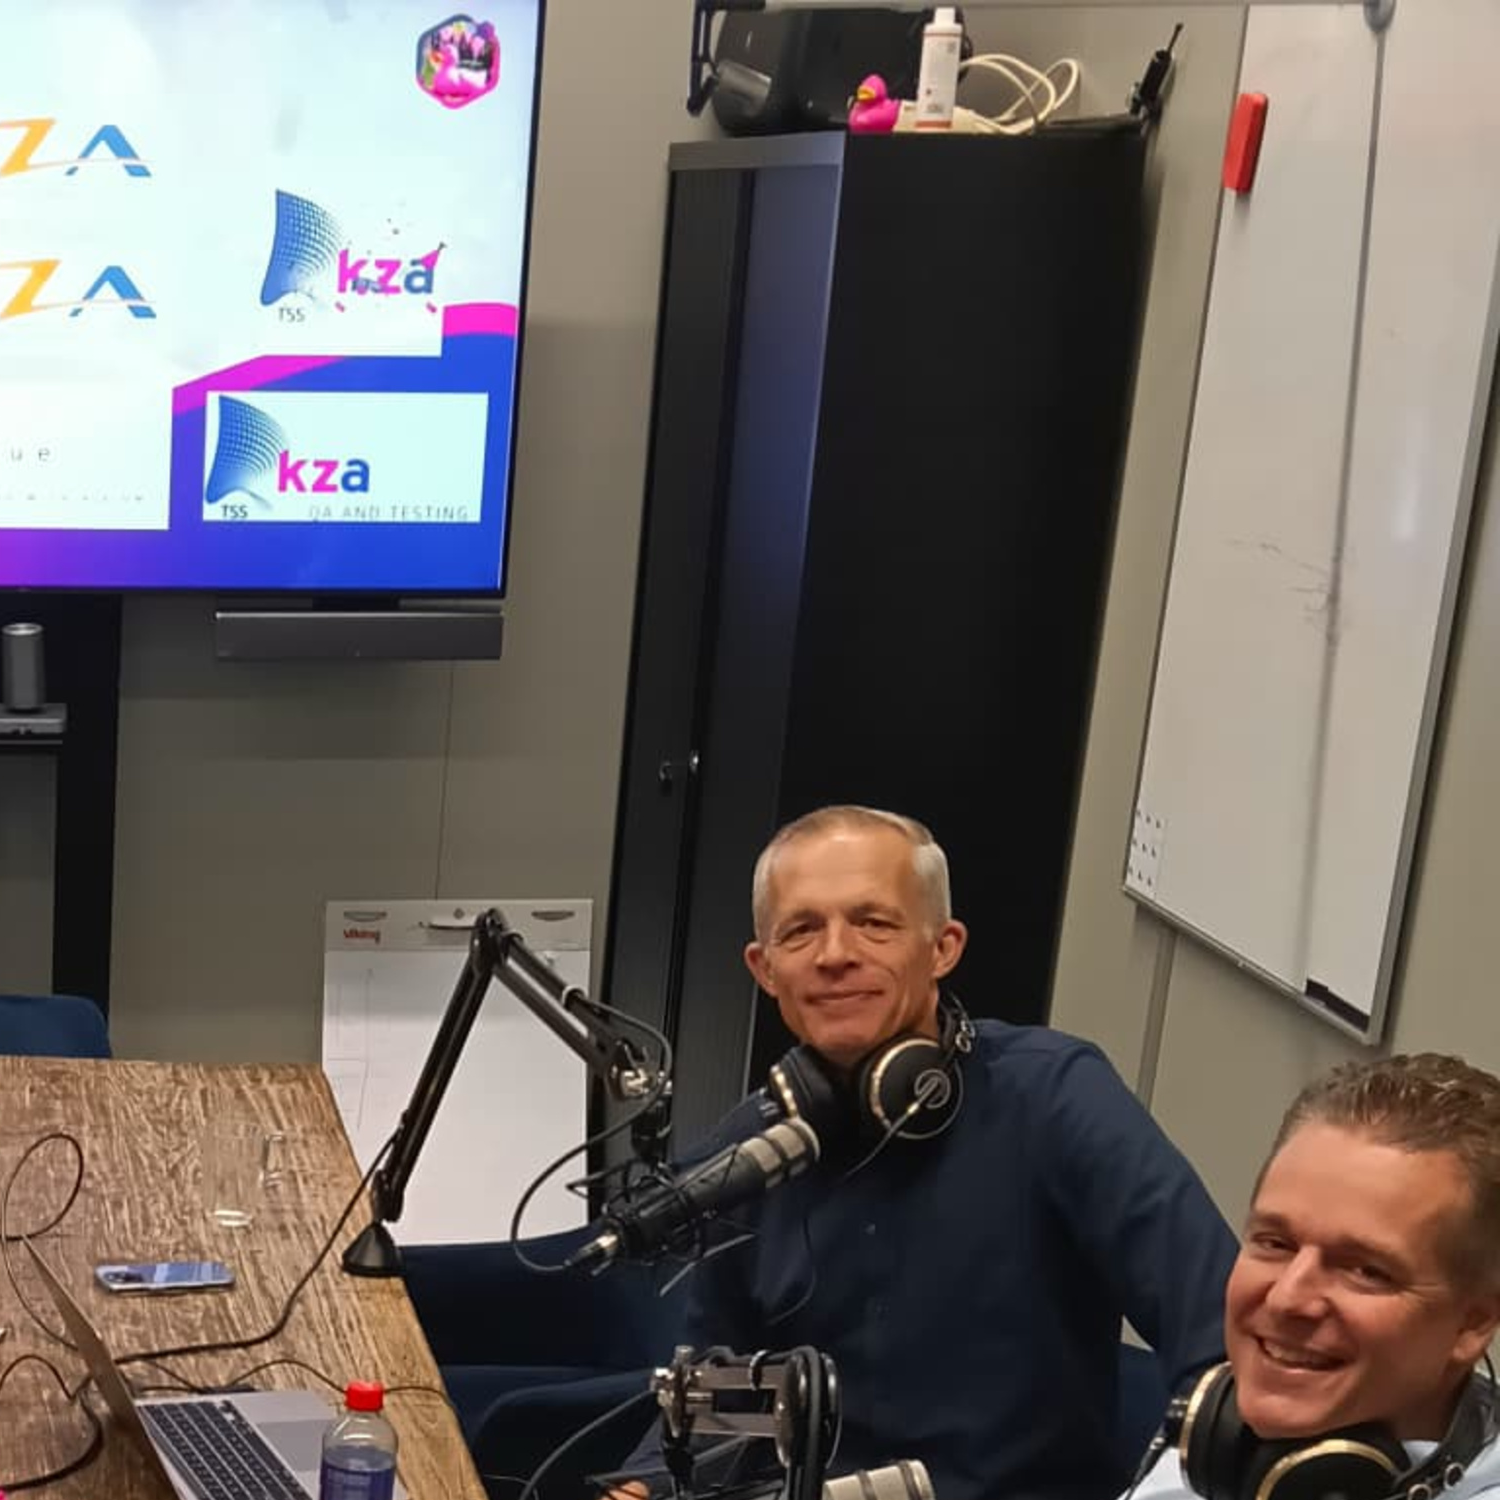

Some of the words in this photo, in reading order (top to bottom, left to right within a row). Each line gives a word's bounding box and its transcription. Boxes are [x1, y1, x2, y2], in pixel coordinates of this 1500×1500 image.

[337, 248, 435, 294] kza
[278, 307, 306, 323] TSS
[277, 449, 370, 493] kza
[221, 504, 248, 519] TSS
[343, 504, 380, 520] AND
[391, 504, 468, 520] TESTING
